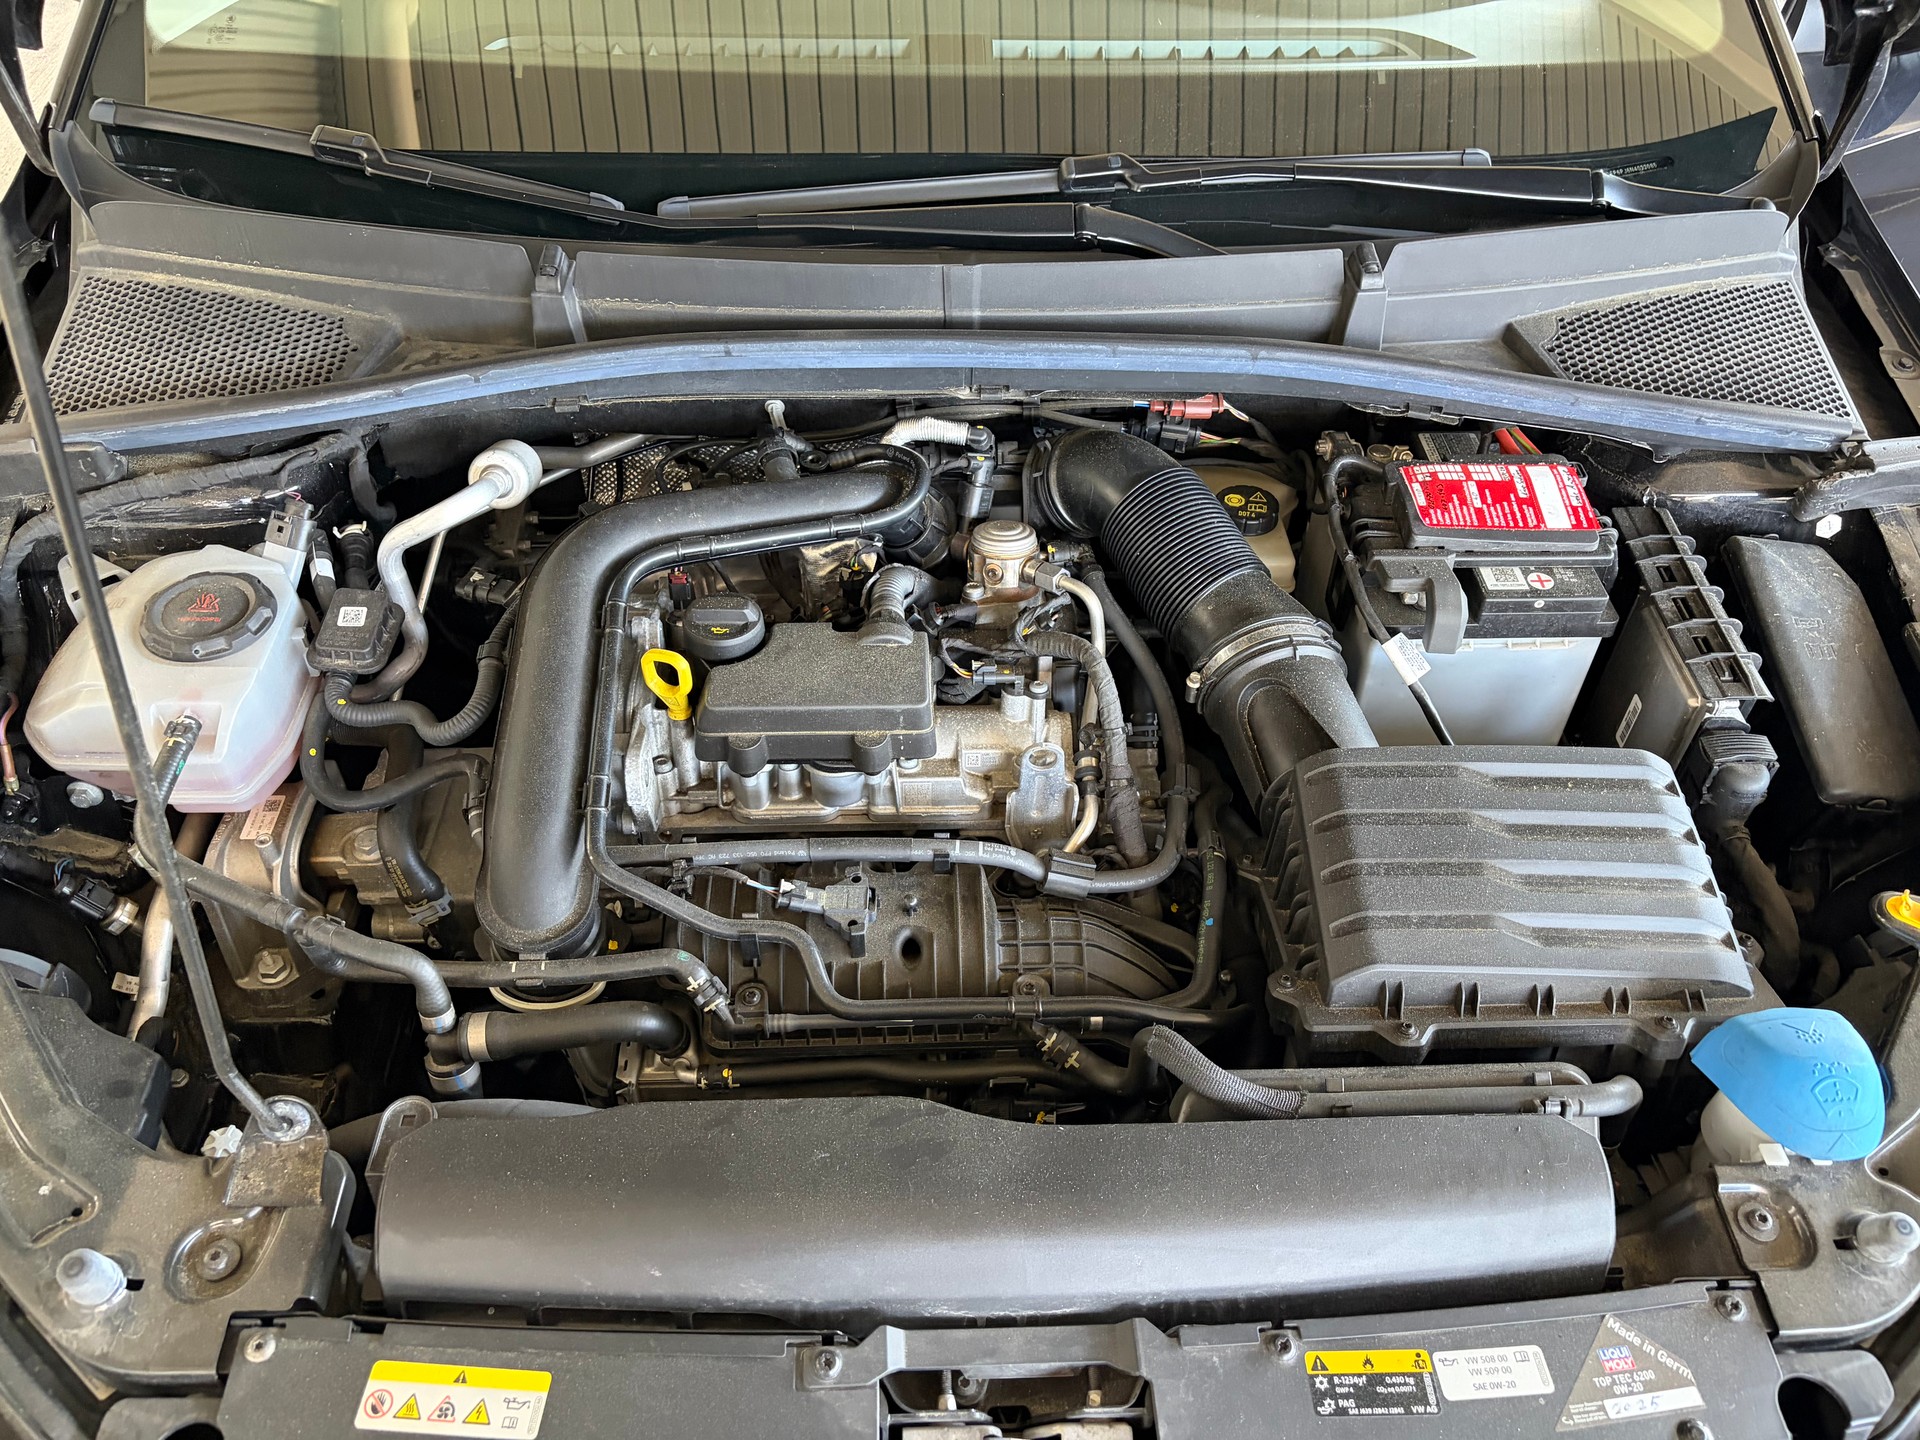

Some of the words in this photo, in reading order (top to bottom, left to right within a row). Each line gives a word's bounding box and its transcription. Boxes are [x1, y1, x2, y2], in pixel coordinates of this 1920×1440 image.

[1599, 1345, 1632, 1360] LIQUI
[1606, 1318, 1641, 1346] Made
[1642, 1341, 1656, 1356] in
[1657, 1349, 1696, 1383] Germ
[1463, 1356, 1478, 1365] VW
[1480, 1355, 1496, 1364] 508
[1497, 1354, 1508, 1363] 00
[1604, 1358, 1635, 1372] MOLY
[1468, 1368, 1482, 1376] VW
[1484, 1366, 1500, 1375] 509
[1501, 1365, 1512, 1374] 00
[1333, 1375, 1366, 1386] R-1234yf
[1385, 1376, 1404, 1384] 0.430
[1405, 1375, 1415, 1385] kg
[1592, 1376, 1612, 1388] TOP
[1612, 1373, 1631, 1384] TEC
[1633, 1369, 1656, 1381] 6200
[1335, 1386, 1349, 1394] GWP
[1472, 1382, 1488, 1391] SAE
[1489, 1380, 1517, 1390] 0W-20
[1613, 1382, 1644, 1395] 0W-20
[1338, 1399, 1356, 1408] PAG
[1411, 1405, 1425, 1413] VW
[1426, 1405, 1438, 1413] AG
[1612, 1396, 1662, 1415] 2025
